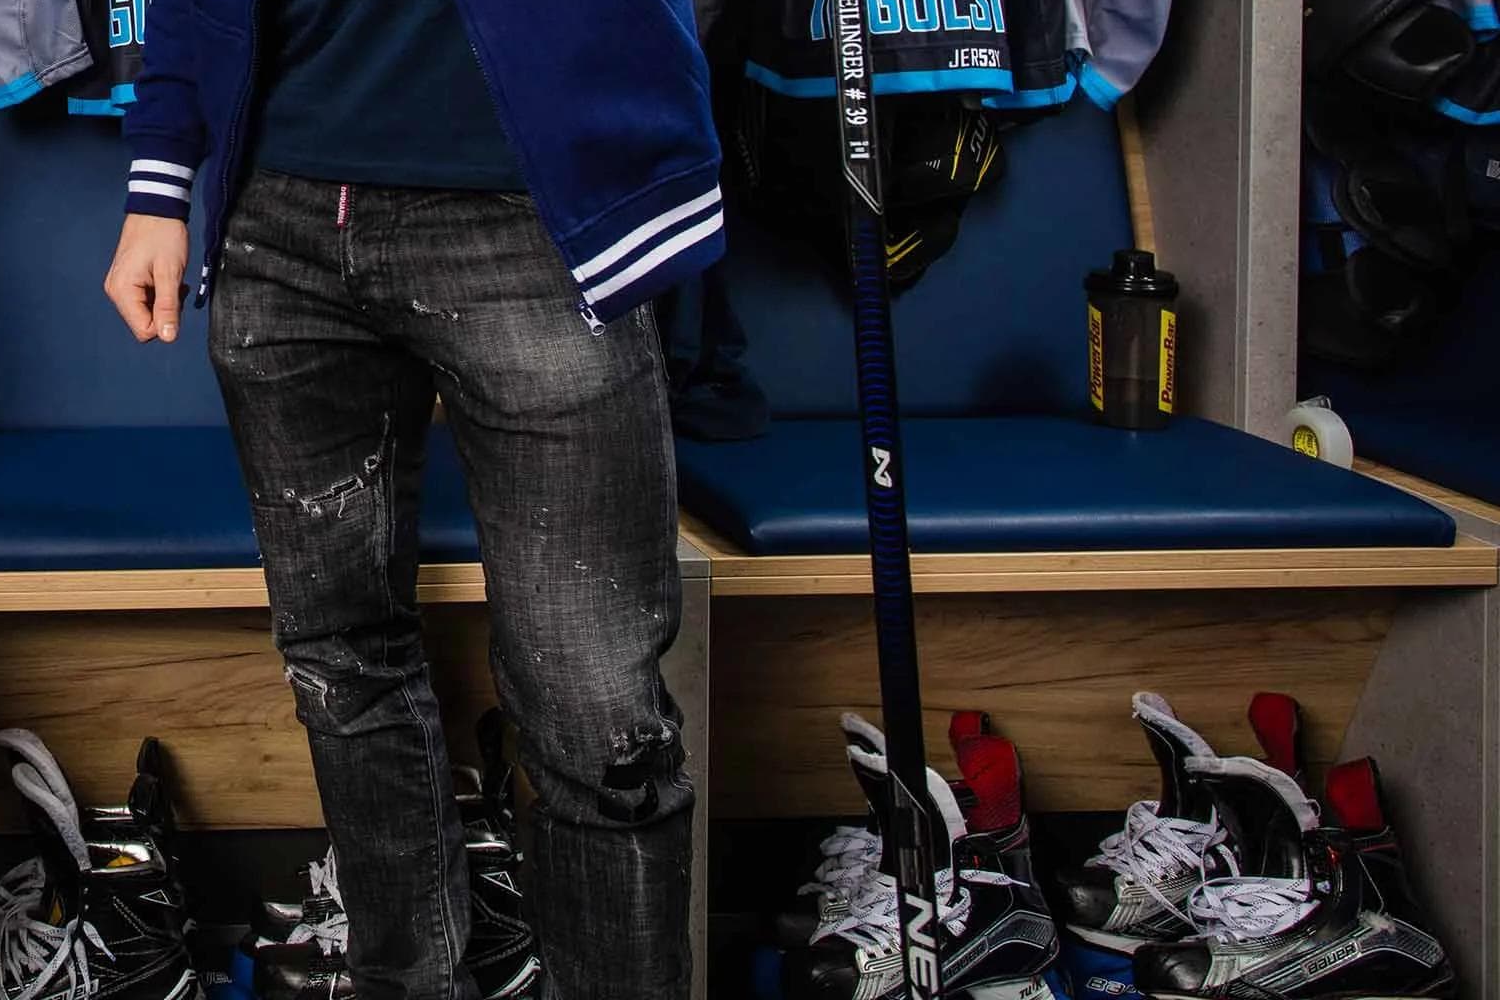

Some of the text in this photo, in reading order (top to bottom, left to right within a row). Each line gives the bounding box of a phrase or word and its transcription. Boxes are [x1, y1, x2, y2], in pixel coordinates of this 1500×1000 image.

[844, 86, 867, 101] #
[845, 106, 868, 126] 39
[1161, 319, 1176, 405] PowerBar
